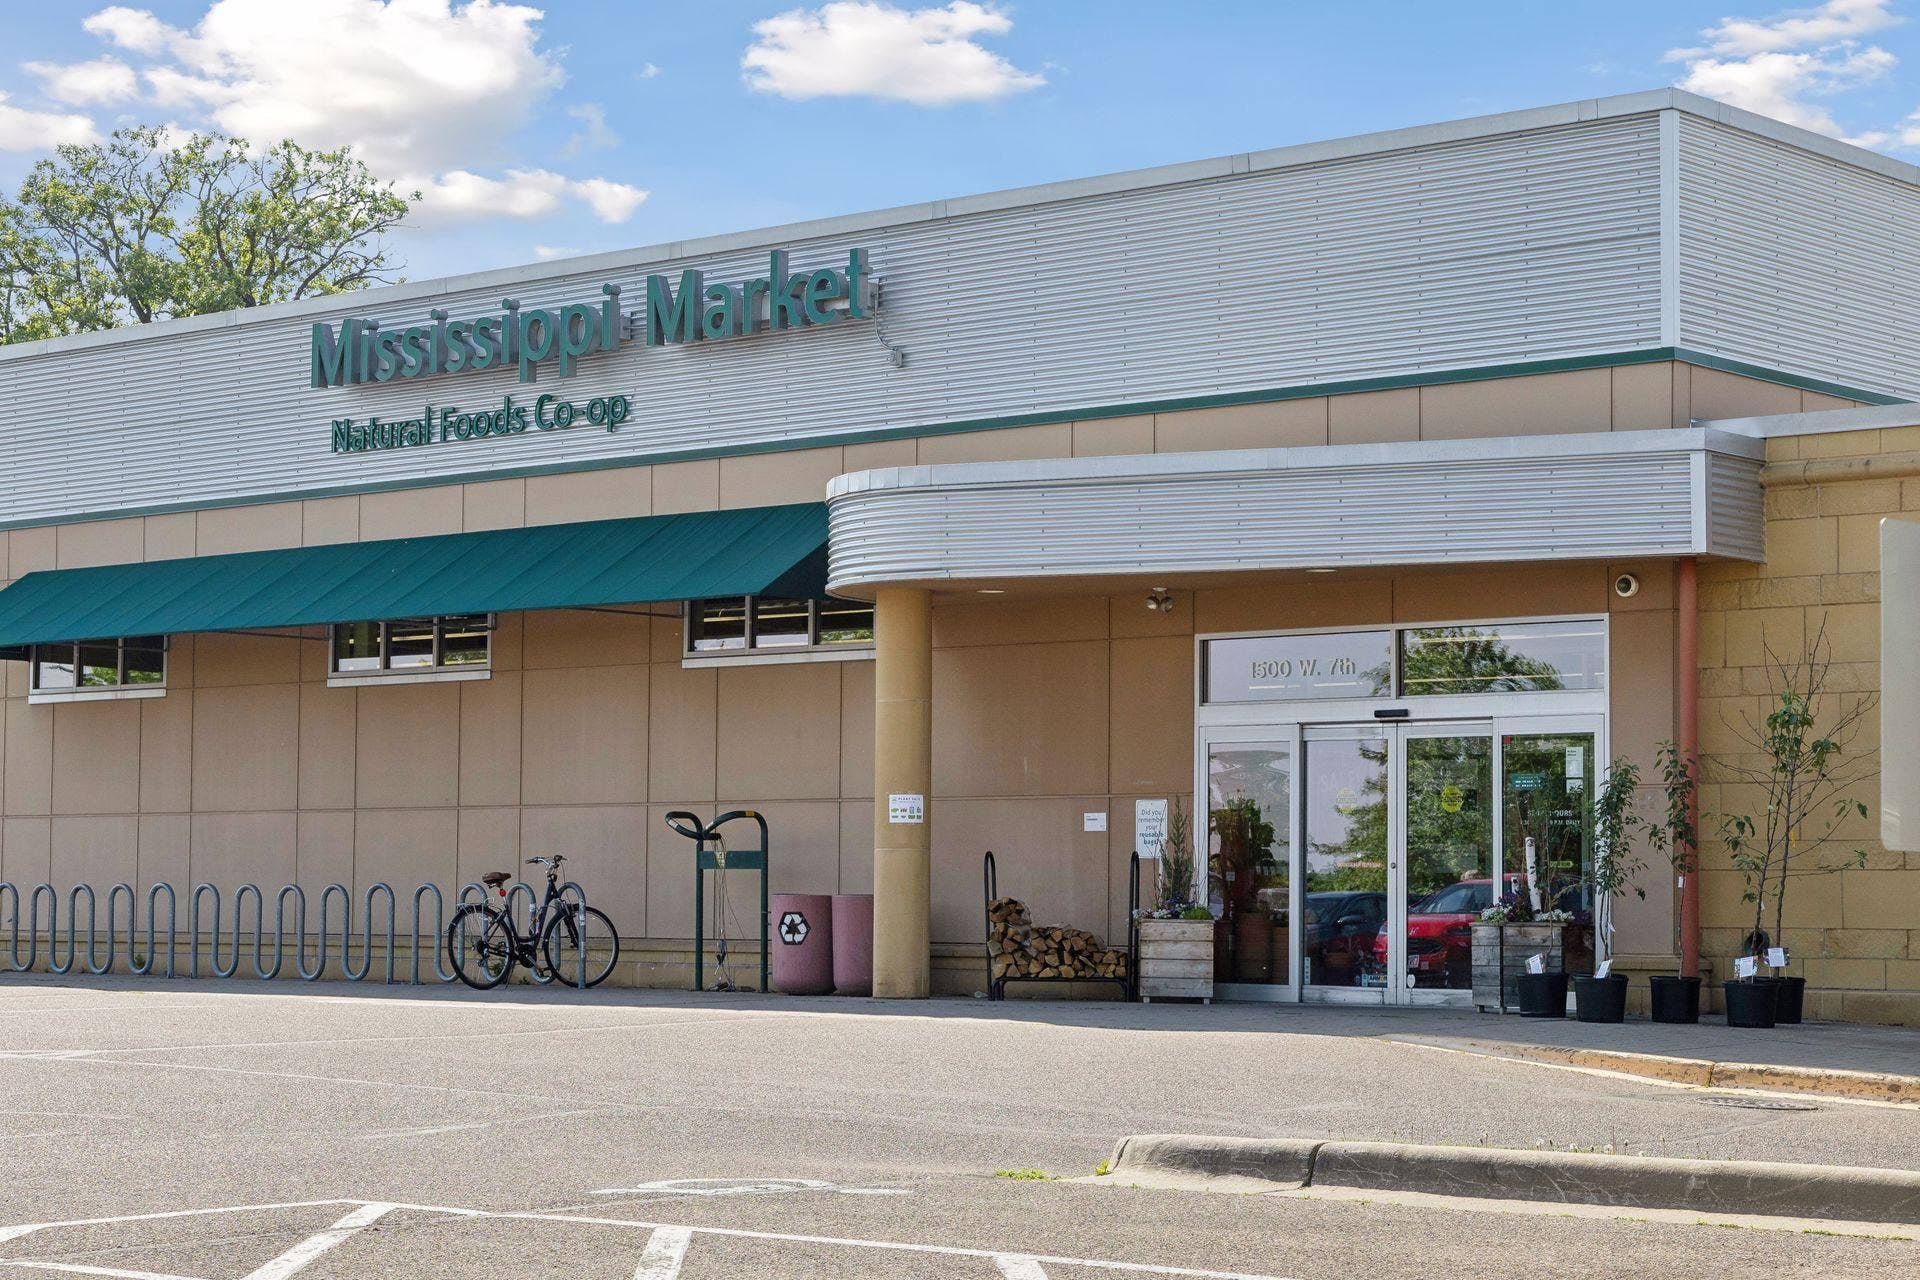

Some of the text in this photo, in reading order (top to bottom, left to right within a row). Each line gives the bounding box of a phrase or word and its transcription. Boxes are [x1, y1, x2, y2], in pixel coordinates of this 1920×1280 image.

[311, 248, 874, 388] Mississippi Market
[331, 393, 628, 453] Natural Foods Co-op
[1250, 656, 1357, 678] 1500 W. 7th
[1141, 808, 1162, 817] Did you
